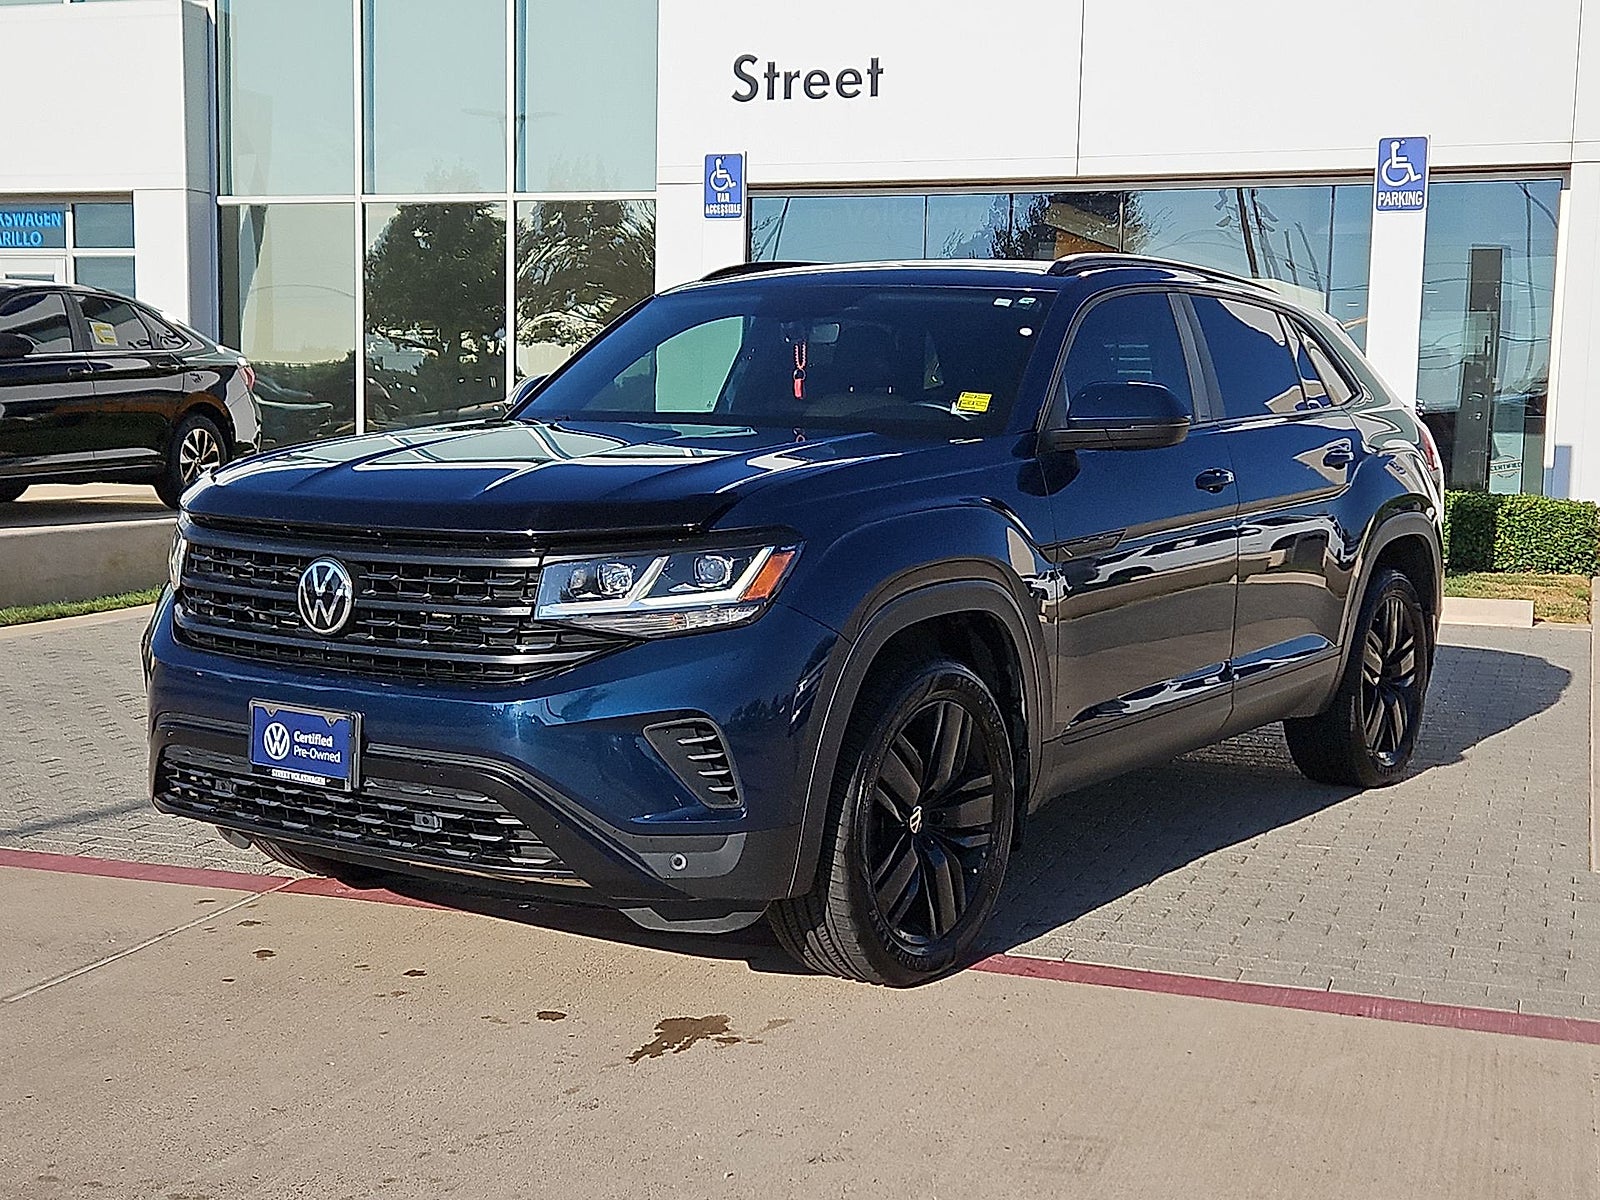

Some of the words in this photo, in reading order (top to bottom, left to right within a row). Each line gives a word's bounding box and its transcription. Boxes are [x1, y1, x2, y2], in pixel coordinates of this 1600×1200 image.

[731, 54, 884, 102] Street
[1378, 190, 1423, 206] PARKING
[294, 730, 333, 748] Certified
[294, 745, 341, 763] Pre-Owned
